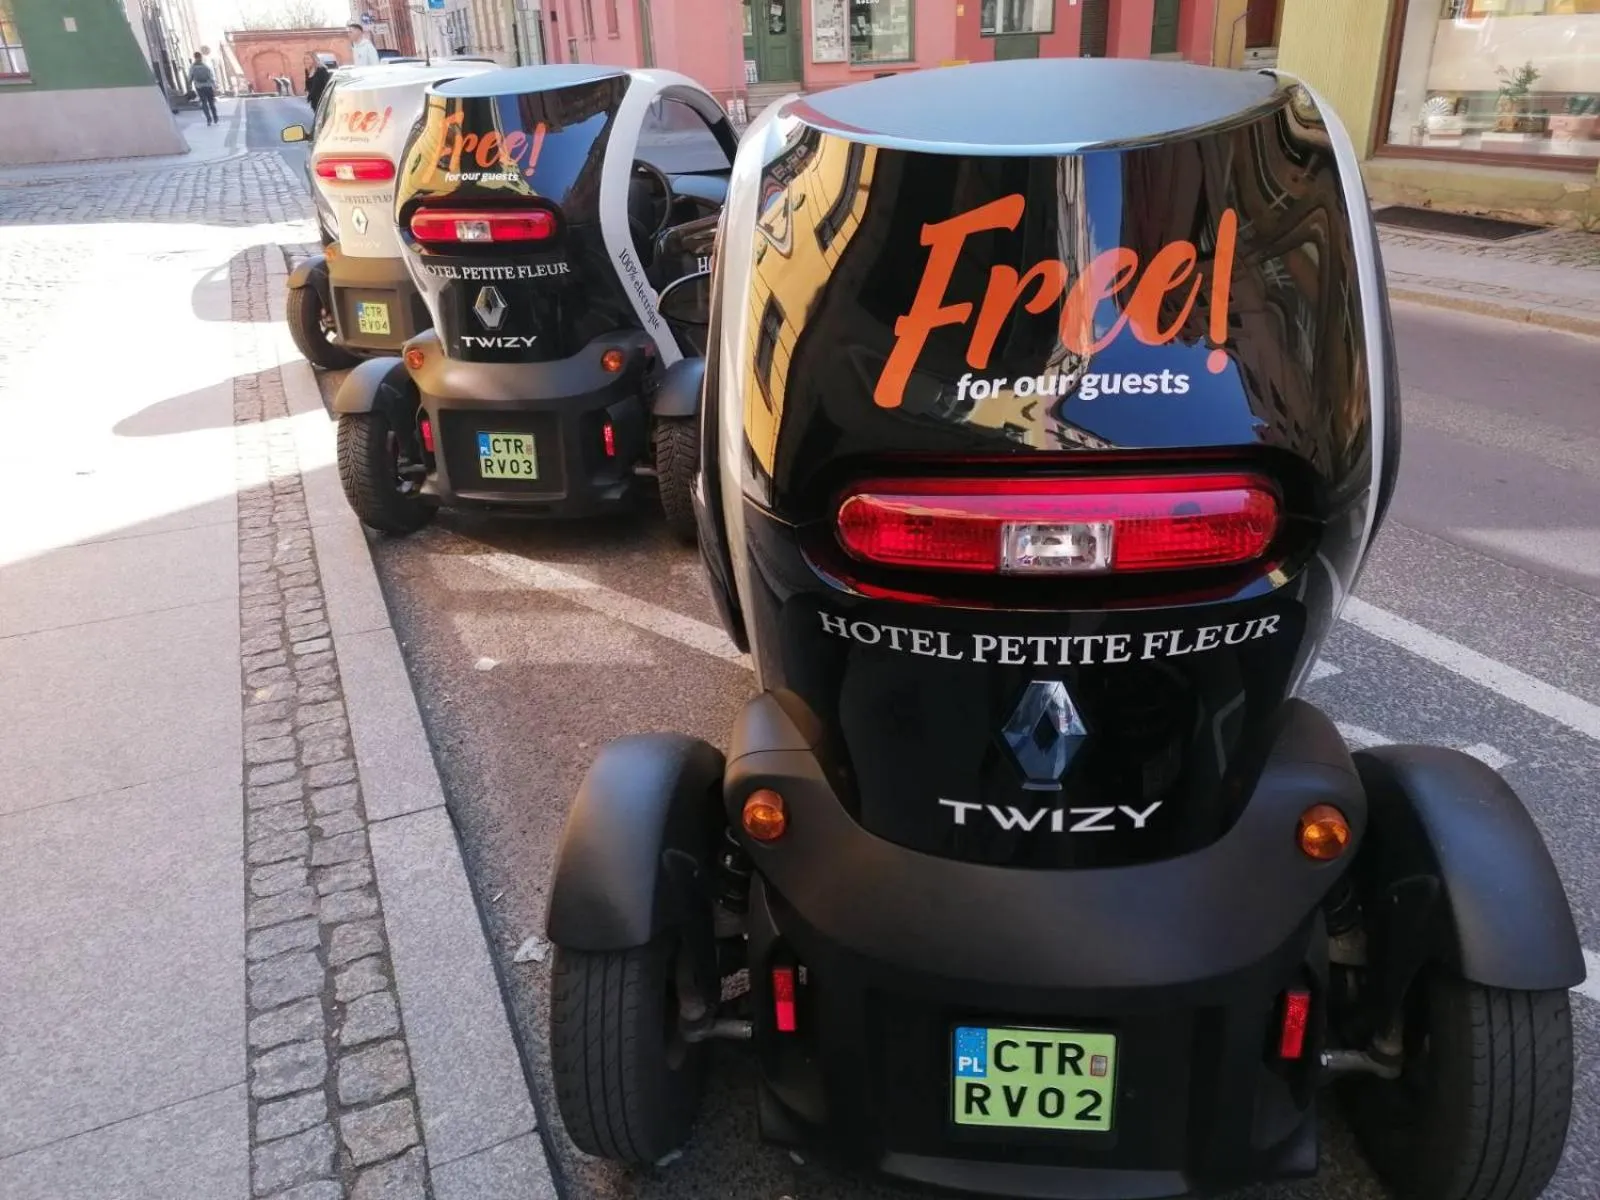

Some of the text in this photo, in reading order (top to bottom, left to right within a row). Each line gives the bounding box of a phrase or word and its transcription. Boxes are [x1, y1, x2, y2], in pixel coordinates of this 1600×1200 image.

[422, 110, 547, 183] Free!
[445, 171, 519, 182] for our guests
[461, 266, 516, 280] PETITE
[517, 262, 571, 279] FLEUR
[873, 193, 1239, 409] Free!
[460, 336, 538, 348] TWIZY
[956, 369, 1191, 401] for our guests
[492, 438, 524, 454] CTR
[484, 458, 533, 475] RV03
[817, 611, 1281, 666] HOTEL PETITE FLEUR
[938, 798, 1164, 832] TWIZY
[958, 1056, 984, 1073] PL
[993, 1040, 1085, 1076] CTR
[964, 1082, 1103, 1121] RV02
